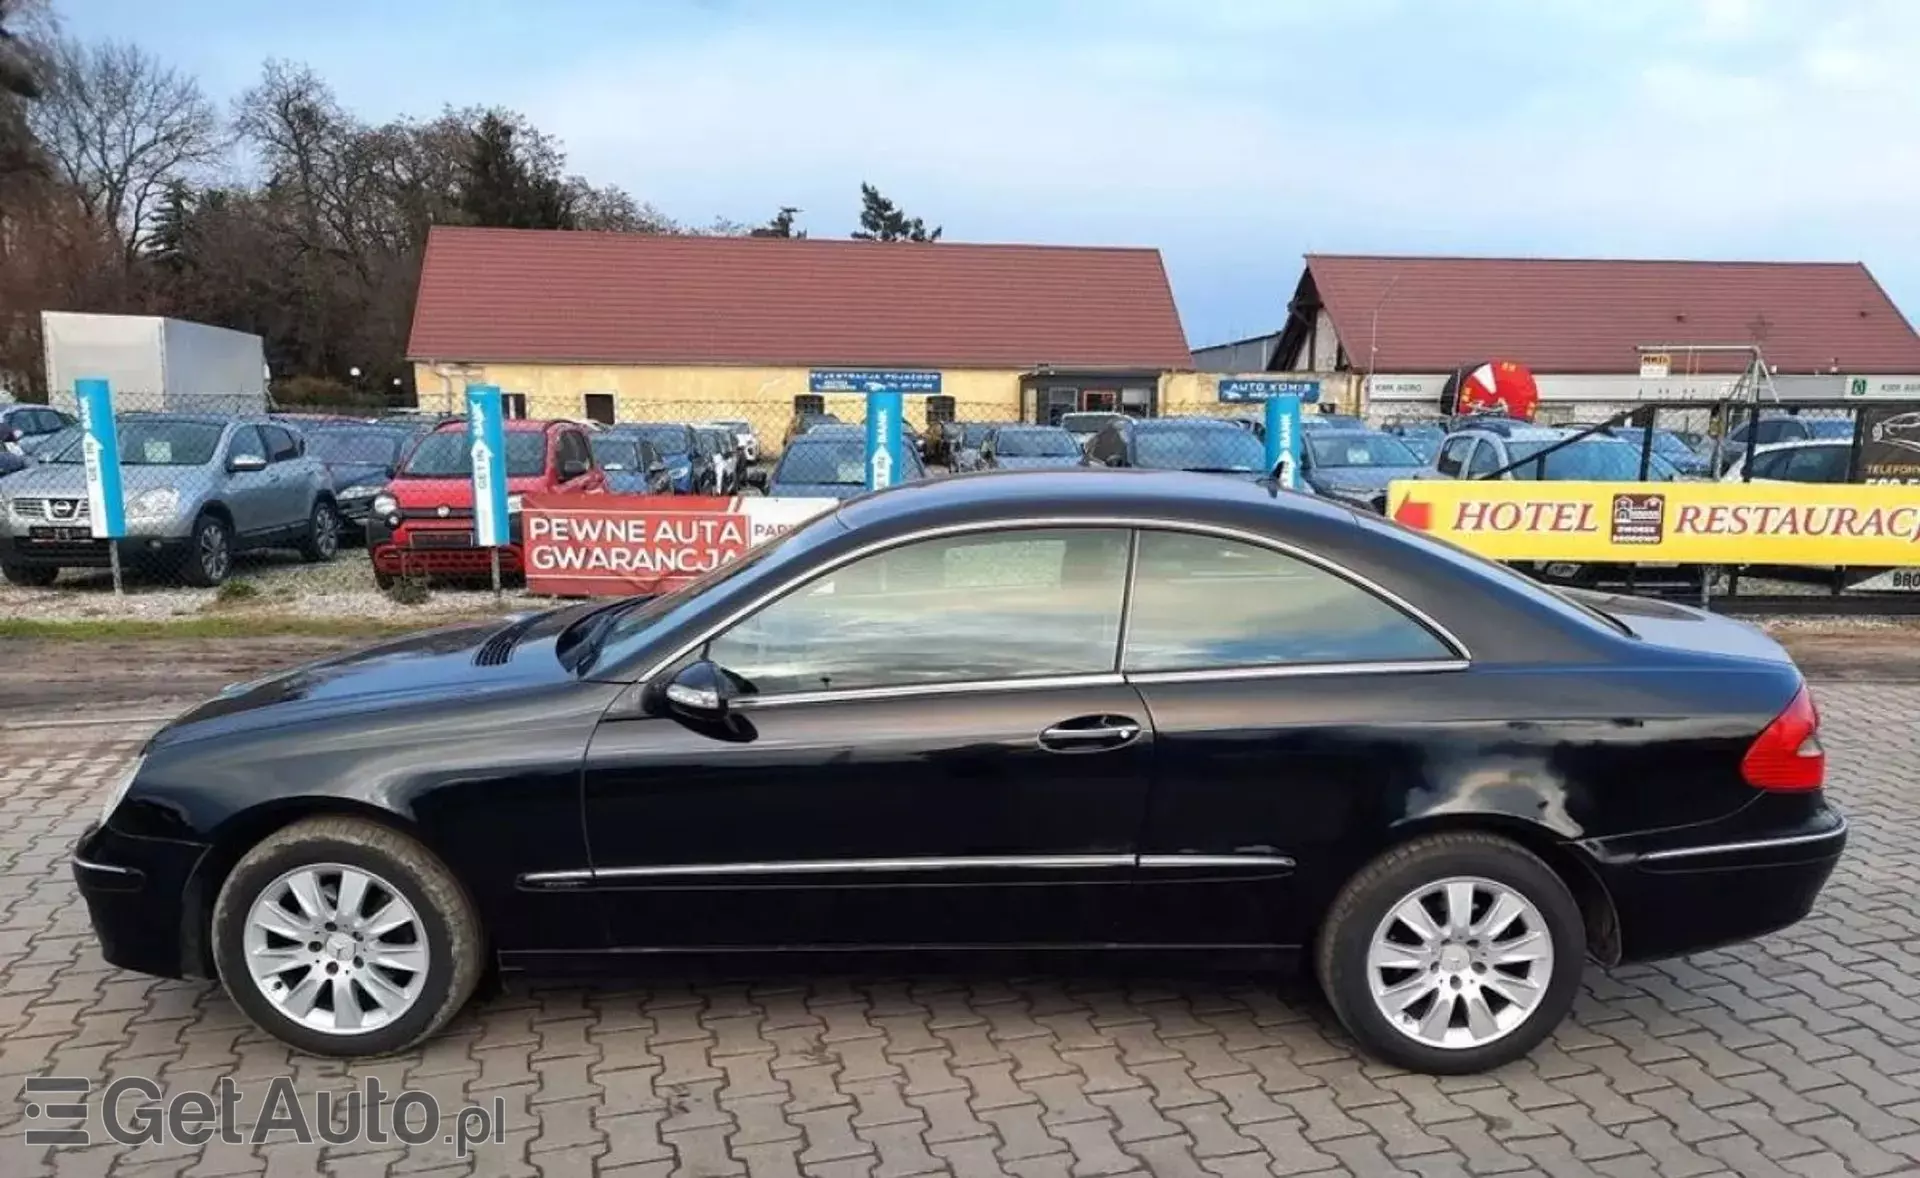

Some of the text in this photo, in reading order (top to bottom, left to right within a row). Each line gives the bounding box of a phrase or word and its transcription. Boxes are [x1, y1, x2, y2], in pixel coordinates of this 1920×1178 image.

[1230, 383, 1265, 392] AUTO
[876, 409, 887, 443] BANK
[1280, 412, 1292, 449] BANK
[529, 518, 742, 545] PEWNE AUTA
[1452, 502, 1599, 533] HOTEL
[531, 546, 738, 572] GWARANCJA
